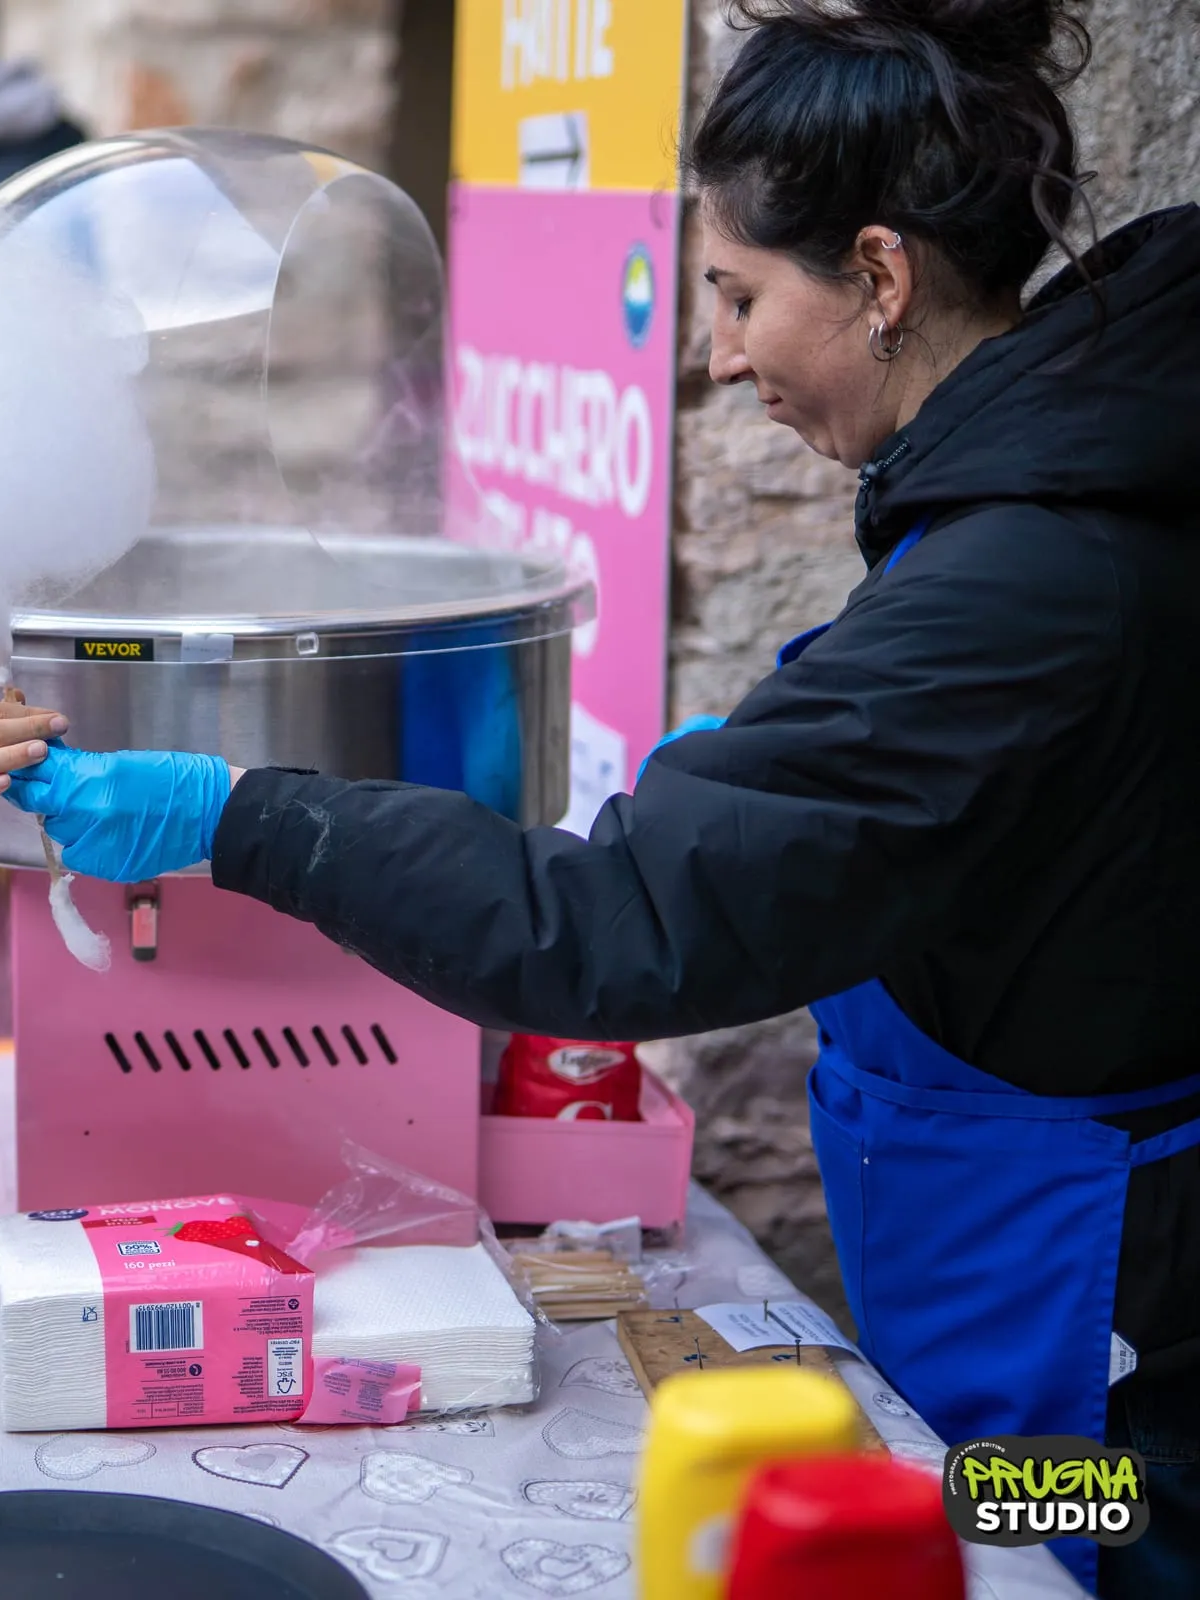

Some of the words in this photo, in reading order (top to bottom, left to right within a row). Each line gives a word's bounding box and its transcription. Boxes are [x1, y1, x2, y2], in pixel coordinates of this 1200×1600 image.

[83, 642, 142, 657] VEVOR
[123, 1261, 145, 1270] 160
[148, 1259, 176, 1271] pezzi
